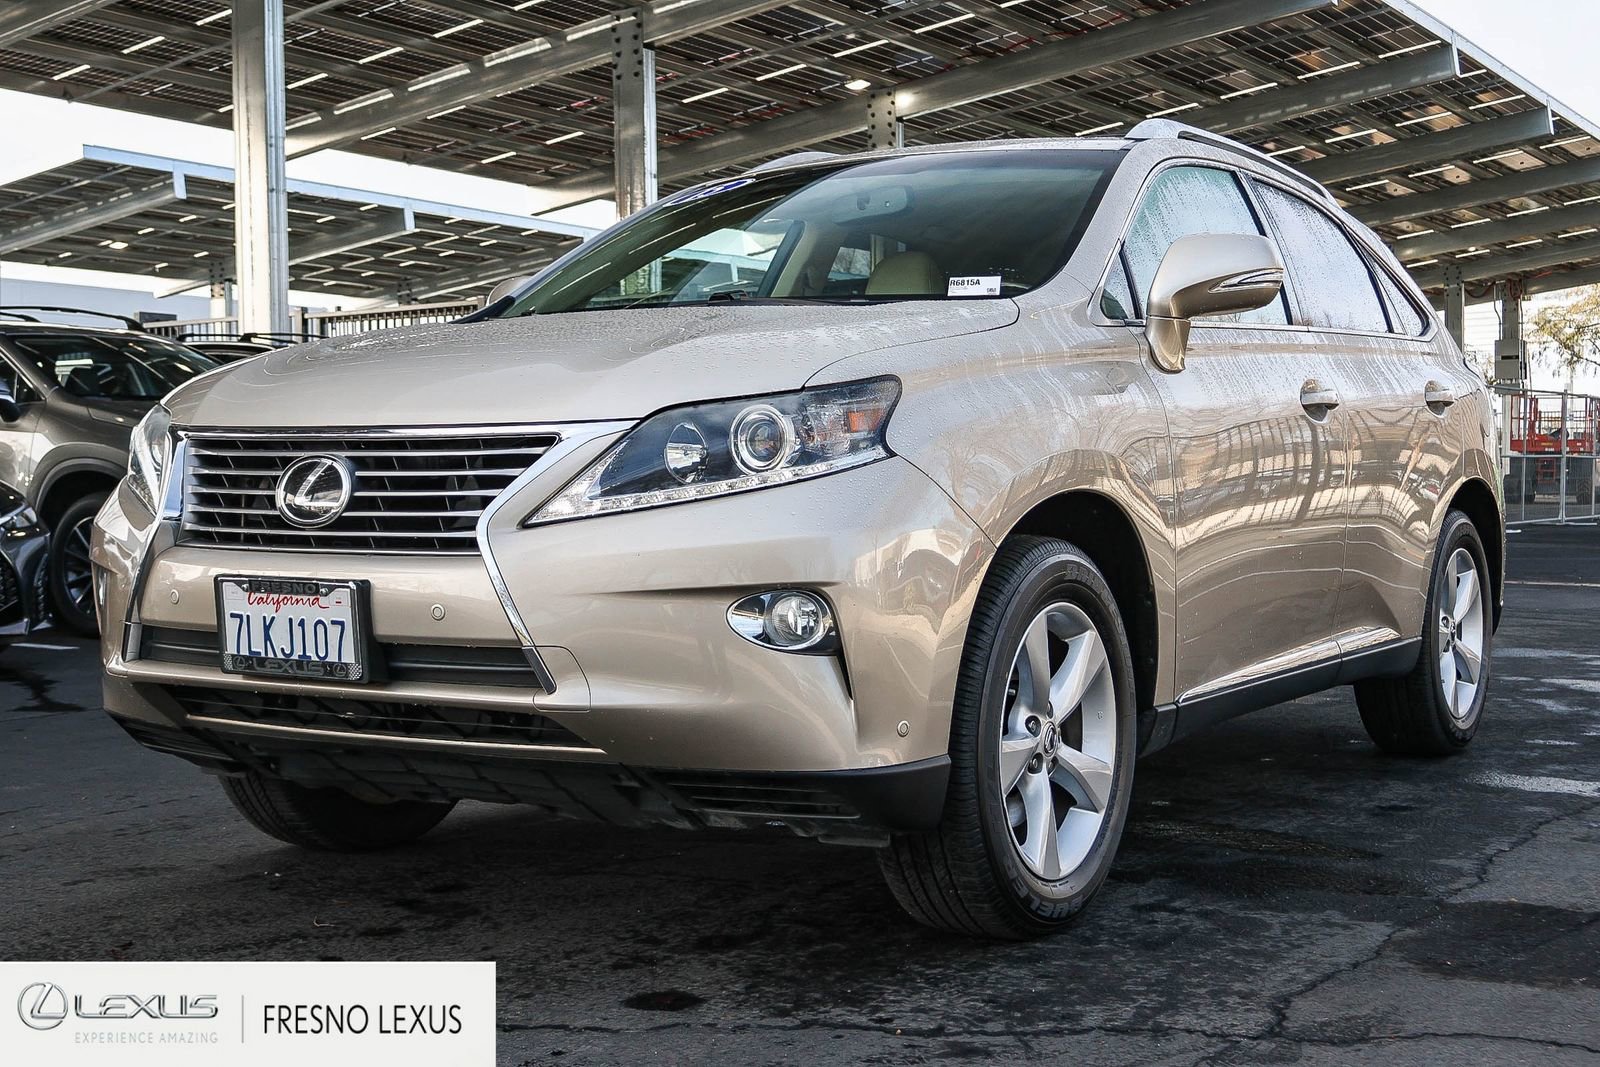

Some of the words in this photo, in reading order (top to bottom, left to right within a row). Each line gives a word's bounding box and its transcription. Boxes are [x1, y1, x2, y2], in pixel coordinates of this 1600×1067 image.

[949, 278, 981, 287] R6815A
[251, 582, 317, 594] FRESNO
[248, 591, 330, 613] California
[229, 611, 346, 663] 7LKJ107
[252, 658, 326, 676] LEXUS
